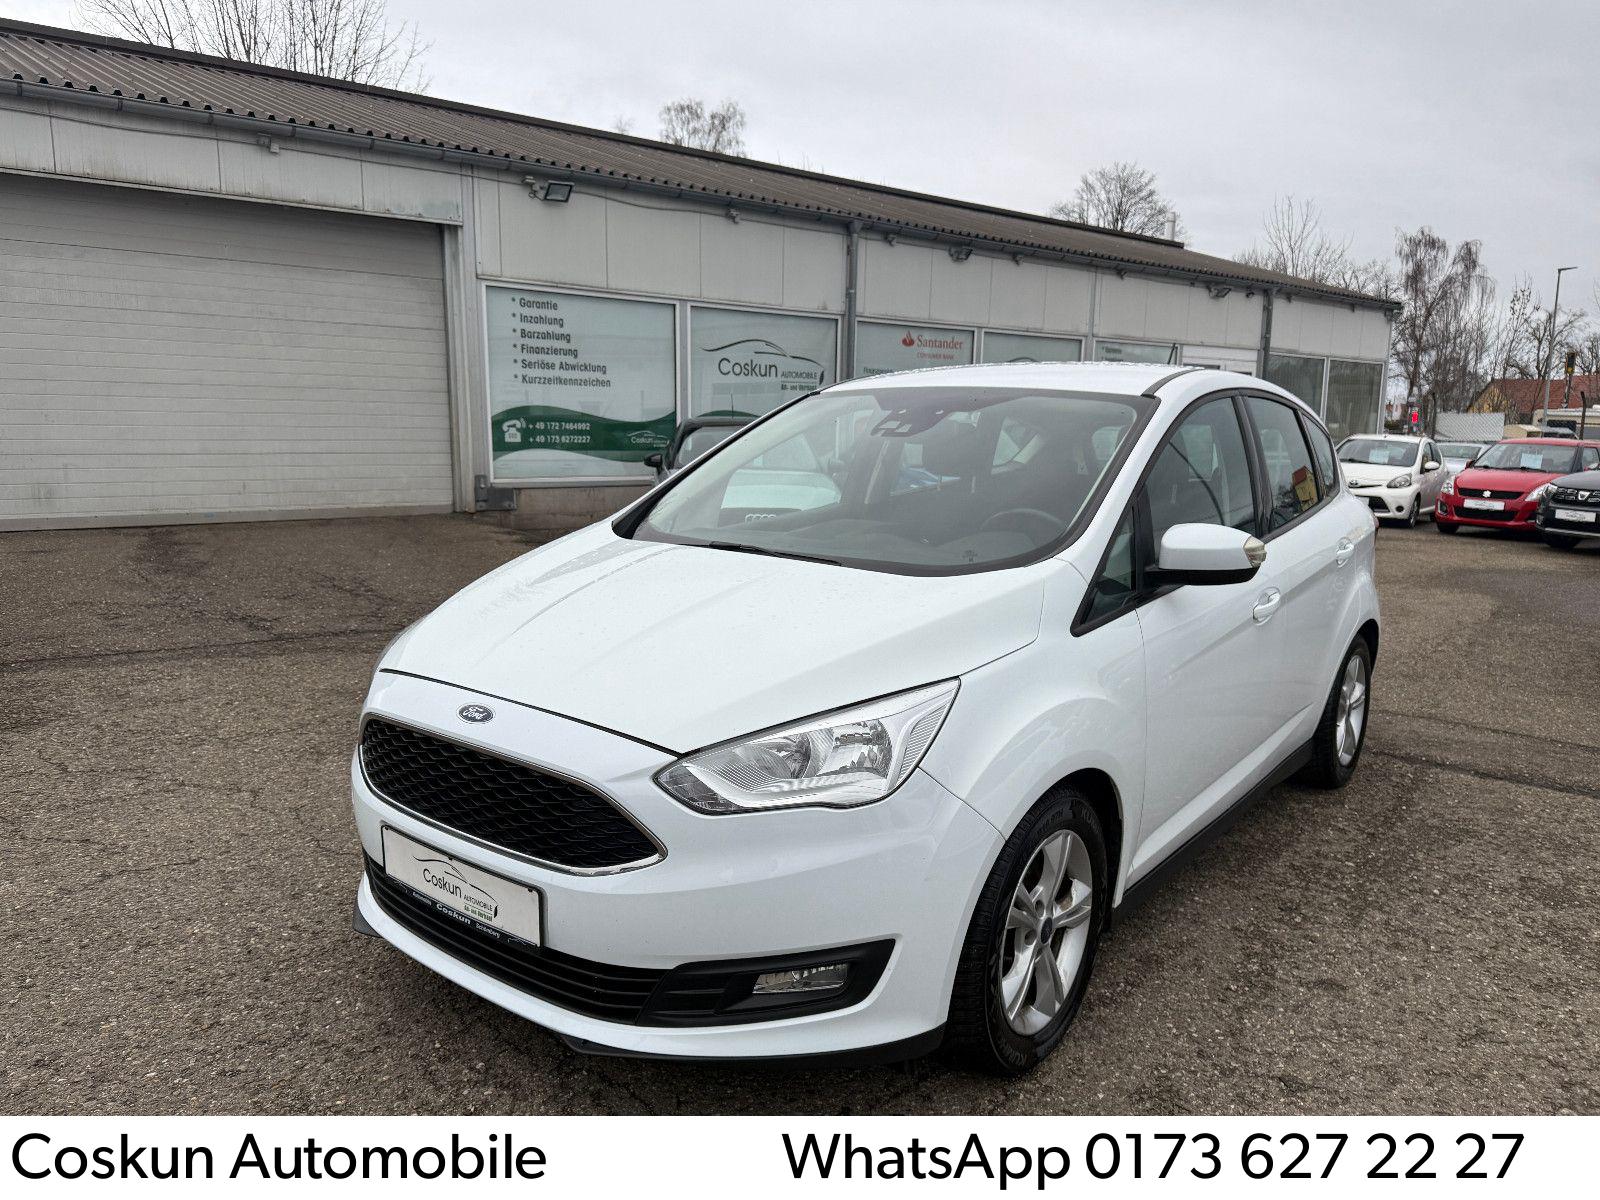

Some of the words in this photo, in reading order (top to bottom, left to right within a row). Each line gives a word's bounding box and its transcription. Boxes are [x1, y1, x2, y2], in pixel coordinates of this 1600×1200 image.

[519, 297, 559, 311] Garantie
[519, 313, 565, 327] Inzahlung
[520, 328, 571, 344] Barzahlung
[916, 334, 964, 350] Santander
[520, 343, 579, 359] Finanzierung
[521, 359, 557, 371] Seriöse
[558, 360, 608, 375] Abwicklung
[717, 357, 779, 378] Coskun
[780, 370, 819, 381] AUTOMOBILE
[521, 374, 612, 388] Kurzzeitkennzeichen
[422, 867, 463, 899] Coskun
[463, 894, 493, 913] AUTOMOBILE
[436, 903, 471, 925] Coskun
